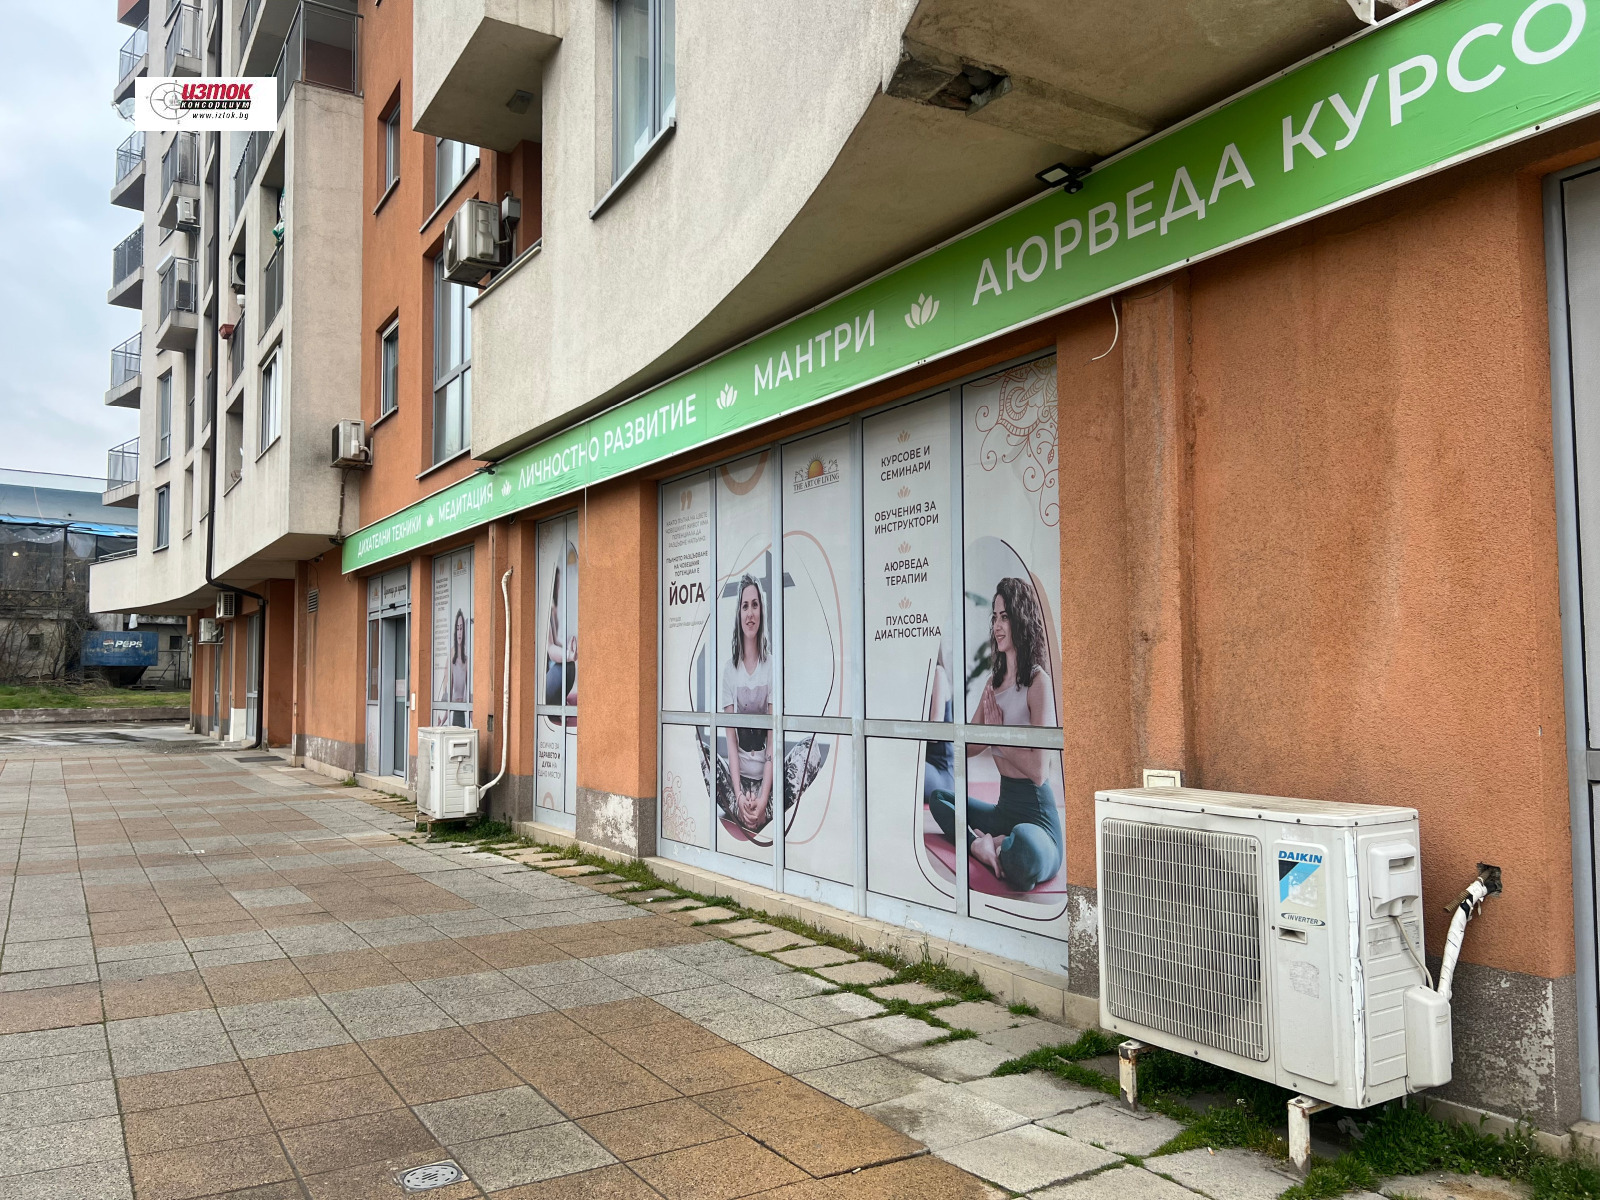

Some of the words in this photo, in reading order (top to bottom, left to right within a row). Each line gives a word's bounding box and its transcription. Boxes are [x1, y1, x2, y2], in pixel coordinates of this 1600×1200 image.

[358, 528, 391, 558] ДИХАТЕЛНИ
[392, 514, 422, 542] ТЕХНИКИ
[438, 482, 493, 522] МЕДИТАЦИЯ
[518, 437, 599, 490] ЛИЧНОСТНО
[604, 393, 697, 456] РАЗВИТИЕ
[754, 309, 875, 396] МАНТРИ
[972, 142, 1255, 306] АЮРВЕДА
[881, 447, 921, 467] КУРСОВЕ
[923, 445, 930, 456] И
[881, 460, 931, 481] СЕМИНАРИ
[793, 483, 804, 491] THE
[804, 480, 813, 488] ART
[814, 478, 821, 486] OF
[821, 473, 840, 484] LIVING
[874, 503, 922, 522] ОБУЧЕНИЯ
[924, 501, 936, 512] ЗА
[874, 513, 939, 535] ИНСТРУКТОРИ
[884, 557, 929, 572] АЮРВЕДА
[885, 572, 928, 586] ТЕРАПИИ
[669, 580, 706, 606] ЙОГА
[885, 613, 929, 626] ПУЛСОВА
[874, 626, 942, 641] ДИАГНОСТИКА
[1278, 850, 1323, 863] DAIKIN
[1287, 914, 1319, 925] INVERTER
